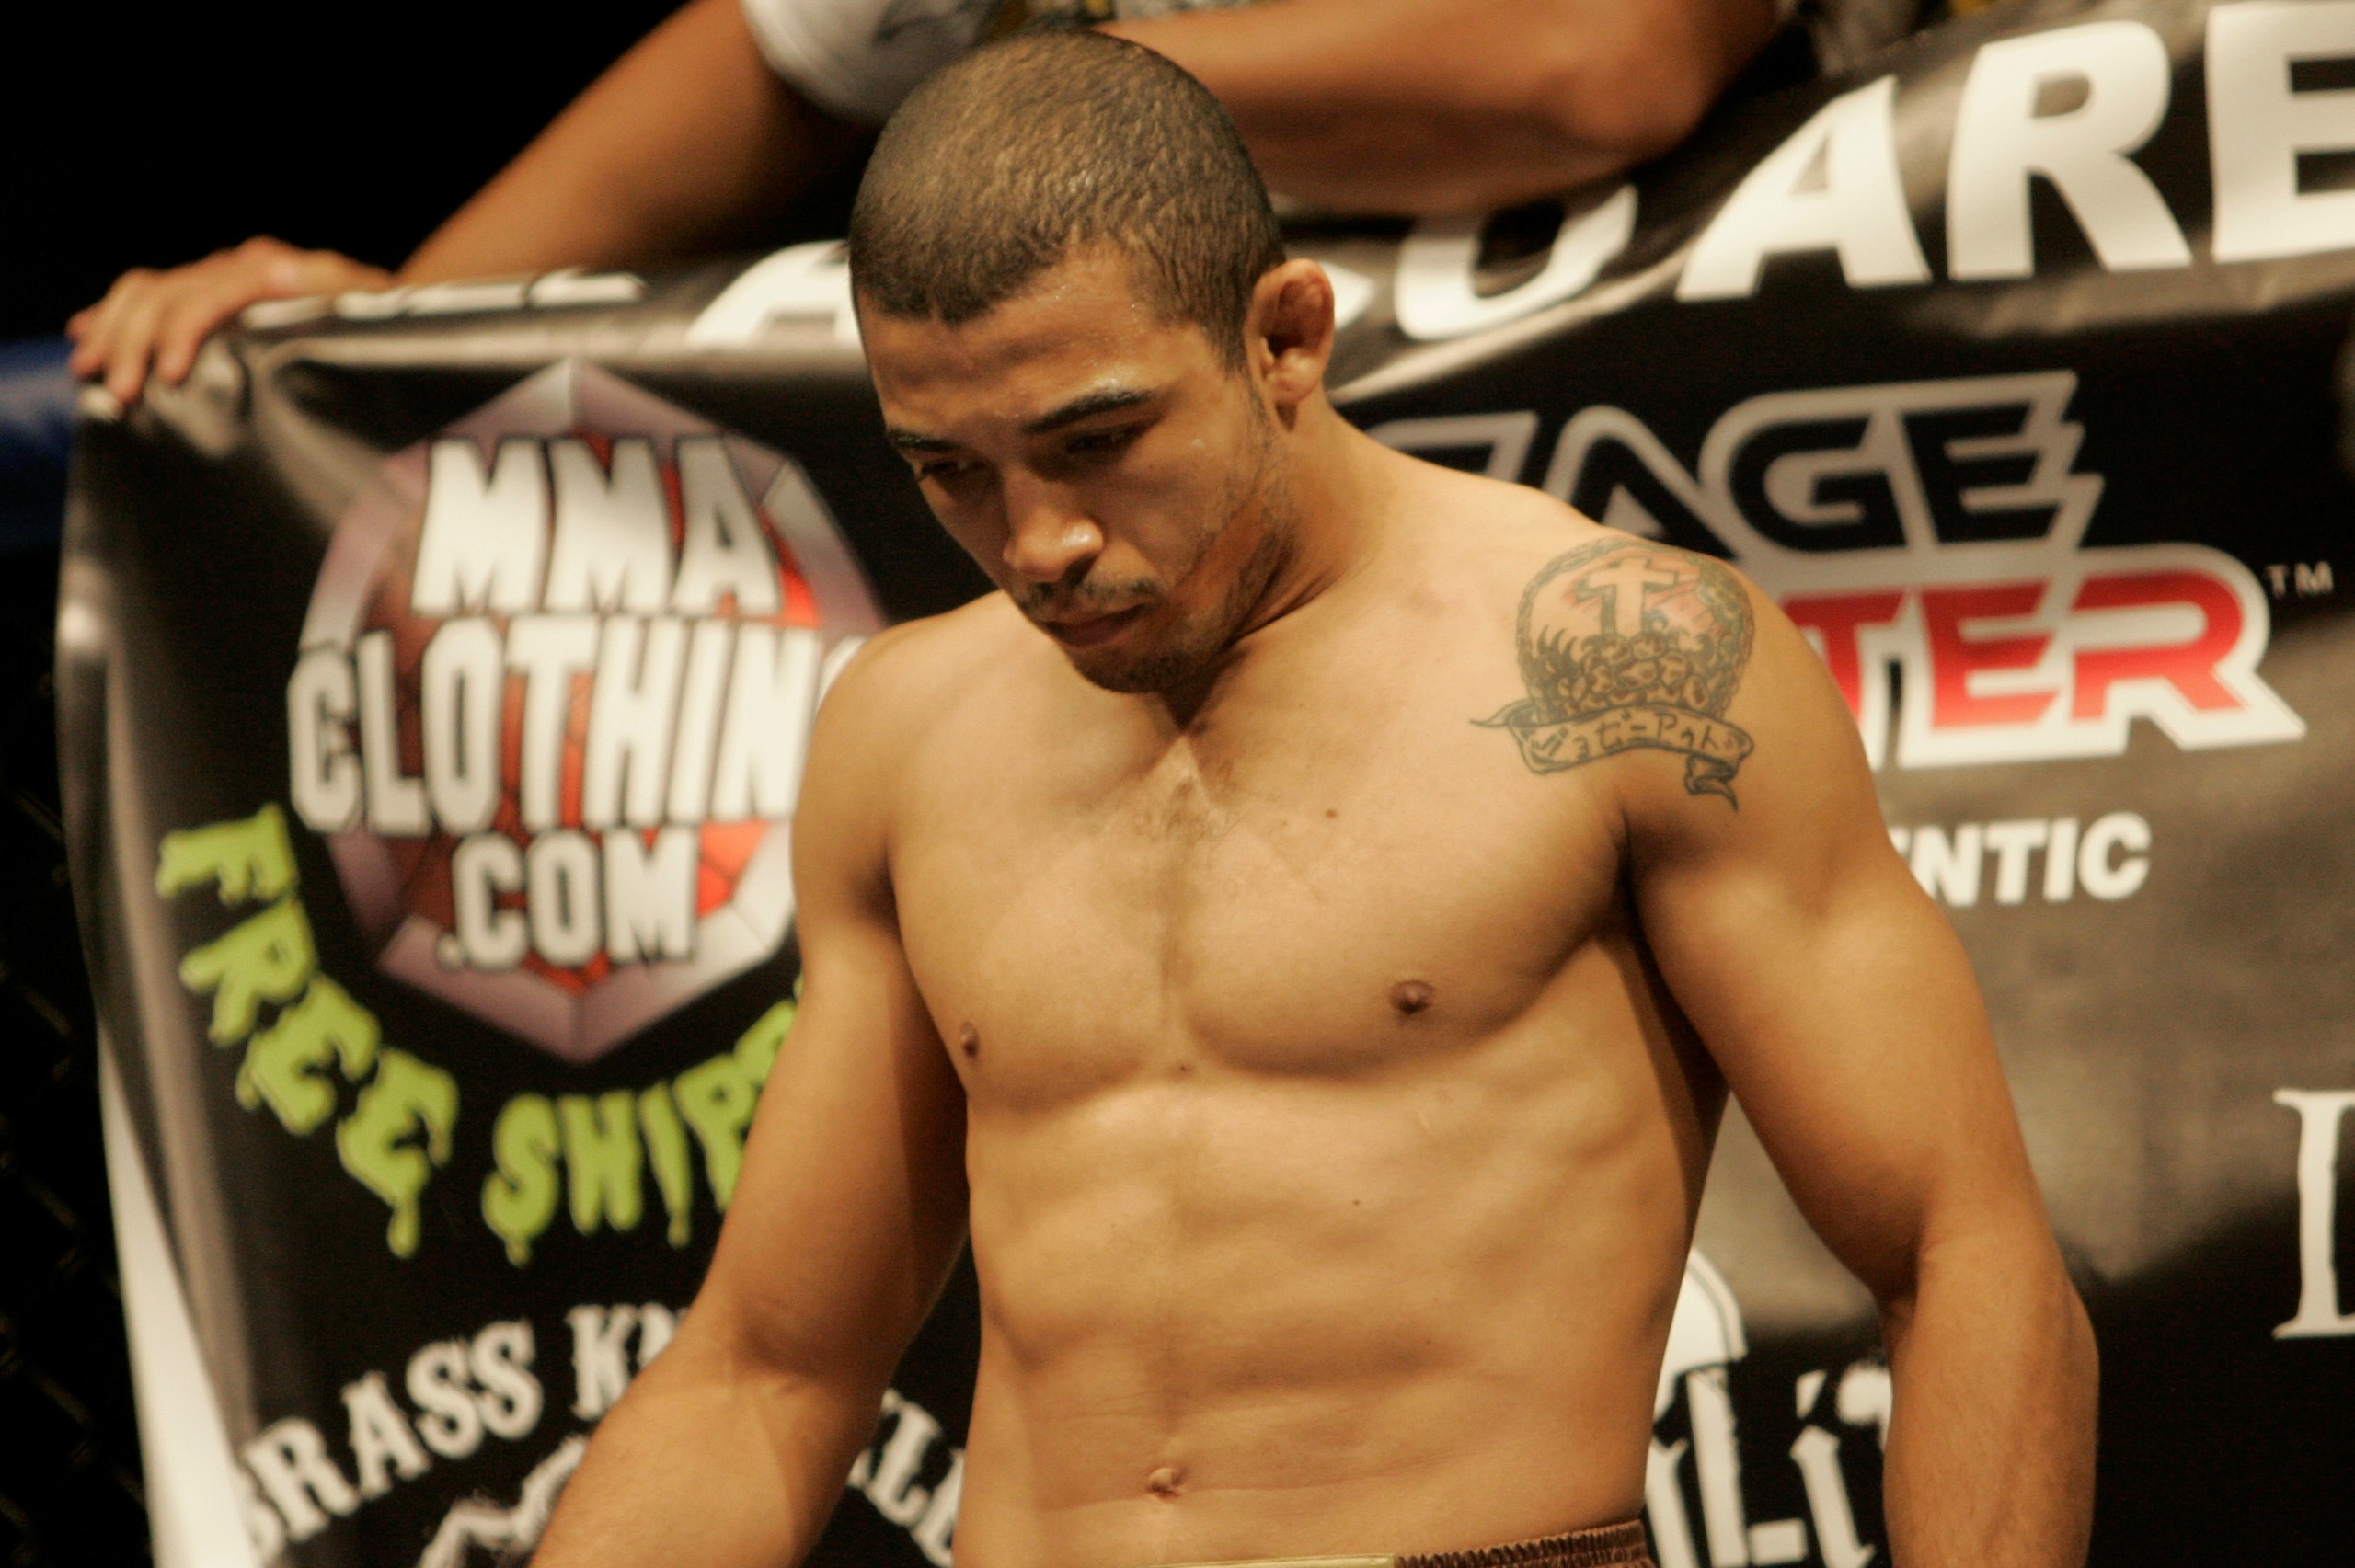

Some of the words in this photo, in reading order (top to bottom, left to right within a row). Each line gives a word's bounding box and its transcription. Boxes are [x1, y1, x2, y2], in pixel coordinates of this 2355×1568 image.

[1325, 2, 2355, 341] UARE
[411, 437, 782, 615] MMA
[1363, 370, 2105, 554] AGE
[286, 616, 868, 837] CLOTHIN
[437, 827, 701, 971] .COM
[155, 802, 460, 1258] FREE
